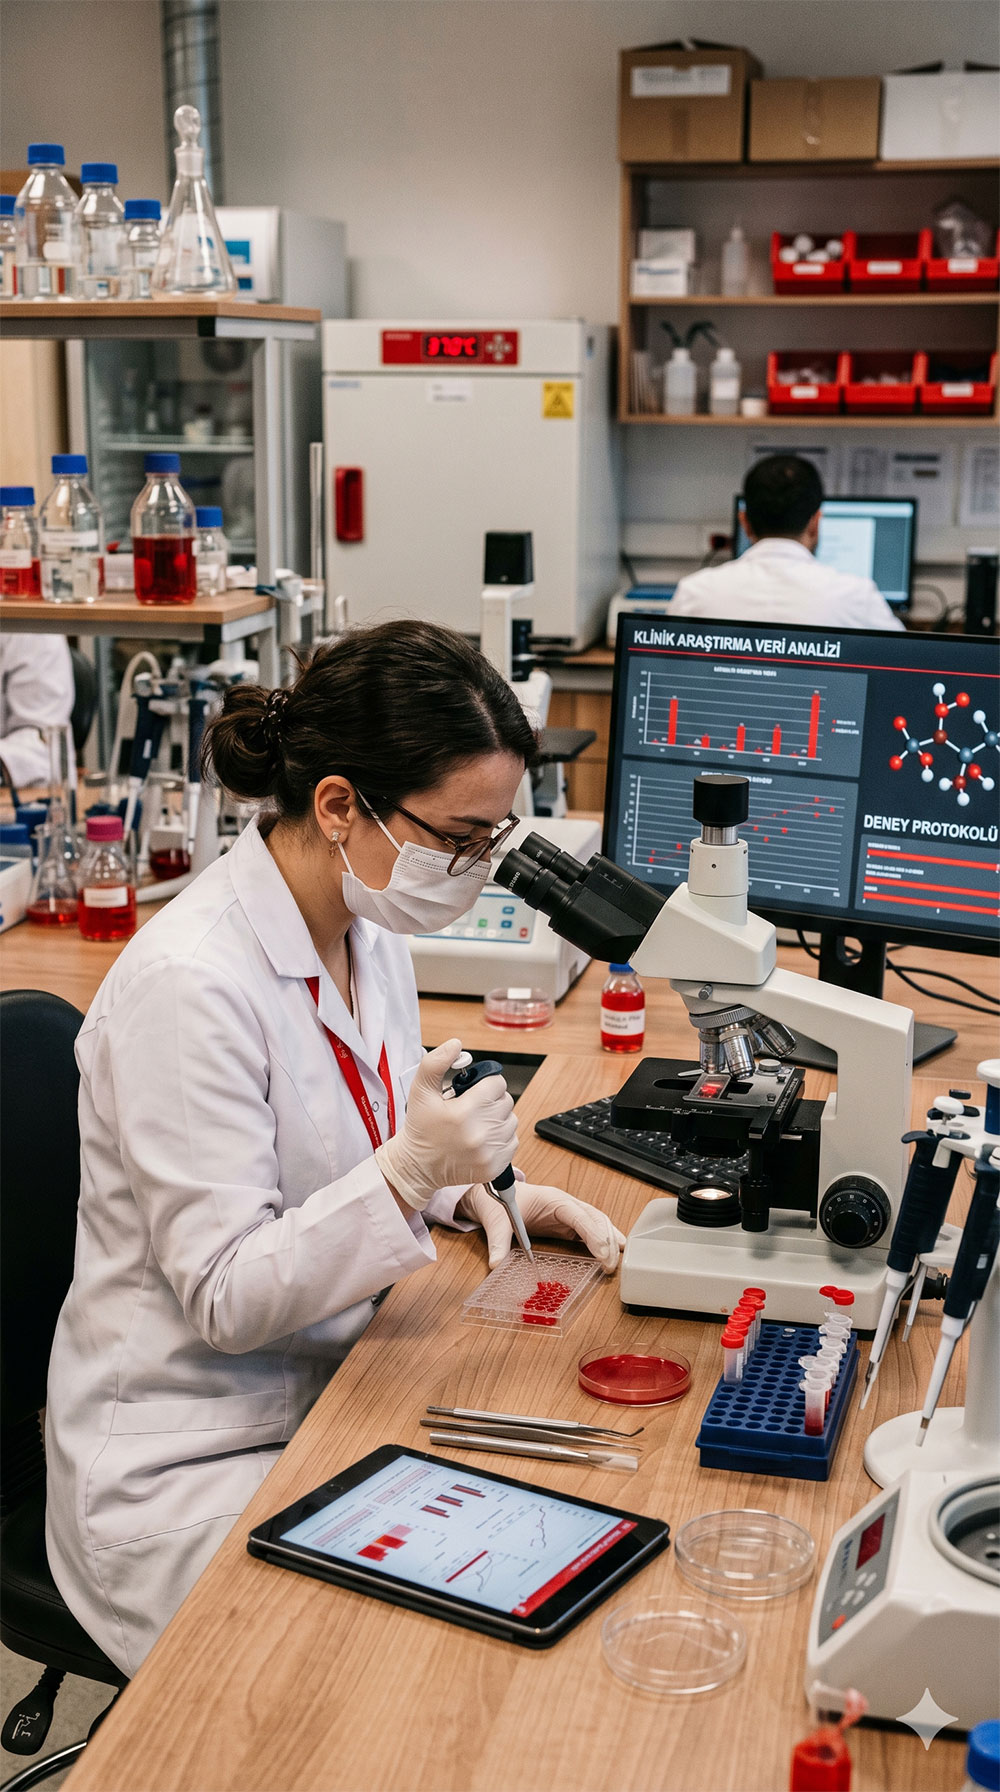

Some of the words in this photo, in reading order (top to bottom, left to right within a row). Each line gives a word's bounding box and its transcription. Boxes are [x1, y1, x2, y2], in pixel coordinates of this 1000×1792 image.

[634, 628, 675, 646] KLİNİK
[677, 633, 753, 652] ARAŞTIRMA
[755, 637, 786, 655] VERİ
[787, 640, 841, 658] ANALİZİ
[863, 814, 910, 832] DENEY
[912, 819, 999, 842] PROTOKOLÜ
